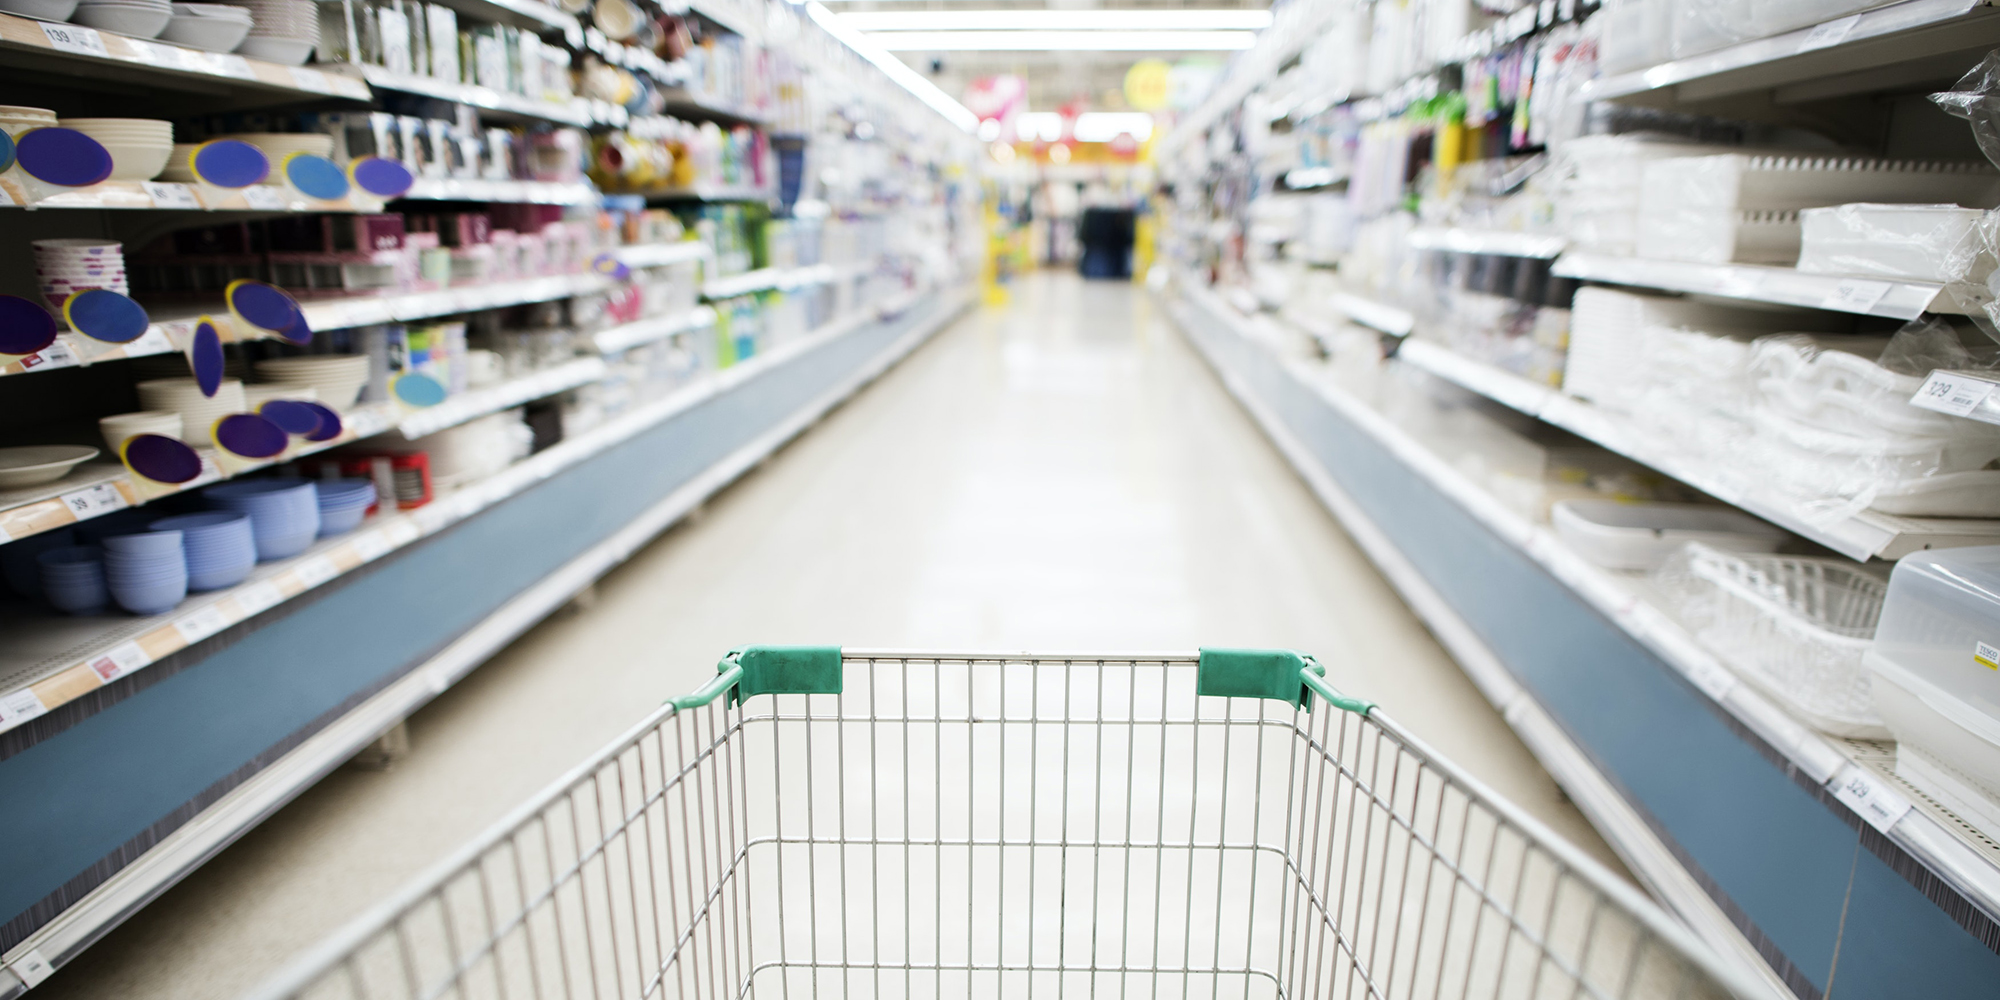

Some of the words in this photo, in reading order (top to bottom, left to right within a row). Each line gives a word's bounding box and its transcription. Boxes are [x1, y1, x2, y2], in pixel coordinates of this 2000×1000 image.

[46, 29, 70, 43] 139
[1929, 381, 1952, 397] 329
[1979, 645, 1998, 658] TESCO
[1846, 778, 1870, 798] 329
